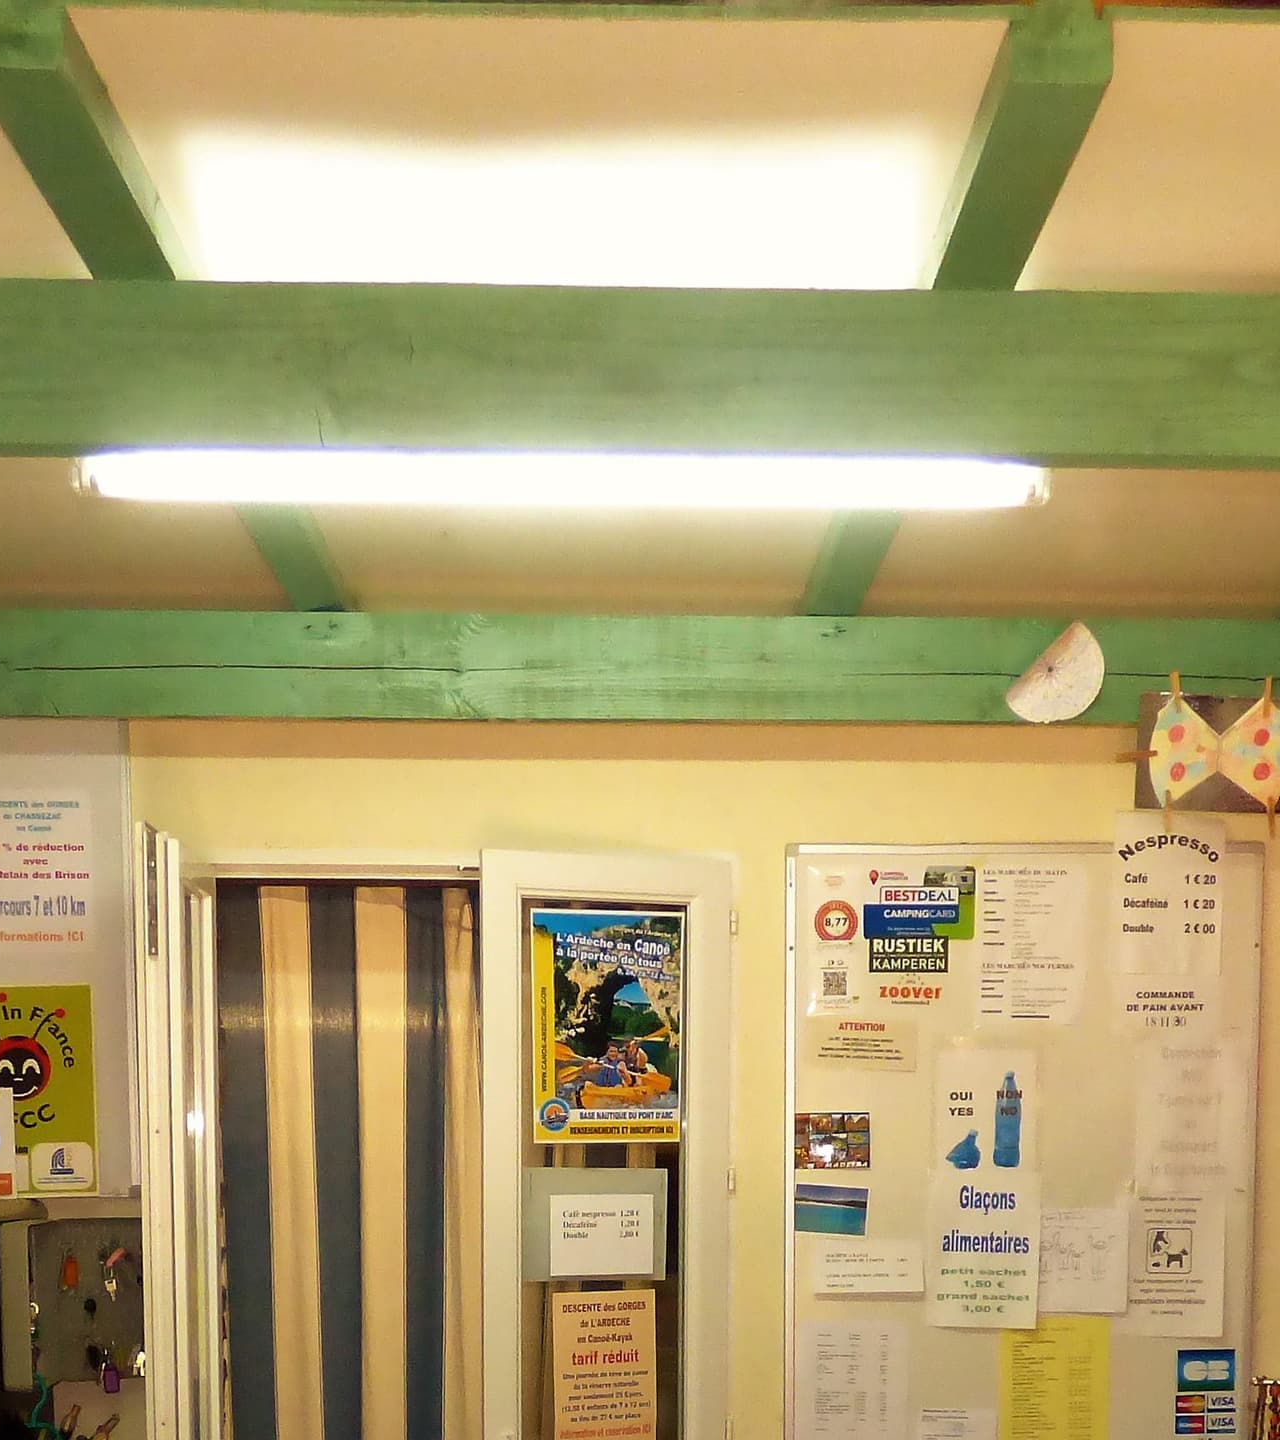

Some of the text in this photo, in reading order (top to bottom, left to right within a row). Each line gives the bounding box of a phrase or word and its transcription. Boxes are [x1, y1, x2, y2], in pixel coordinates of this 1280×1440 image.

[16, 843, 29, 851] de
[32, 842, 84, 851] réduction
[1118, 834, 1219, 863] Nespresso
[32, 870, 51, 879] des
[55, 870, 89, 879] Brison
[1125, 873, 1148, 883] Café
[1194, 874, 1200, 884] €
[1203, 874, 1216, 885] 20
[884, 890, 955, 902] BESTDEAL
[43, 897, 53, 916] et
[56, 895, 67, 916] 10
[70, 895, 85, 916] km
[1193, 899, 1199, 909] €
[1202, 899, 1215, 909] 20
[824, 917, 848, 928] 8,77
[1123, 923, 1215, 934] Double 2 € 00
[556, 932, 614, 949] L'Ardèche
[616, 941, 631, 951] en
[873, 938, 945, 953] RUSTIEK
[567, 947, 577, 958] la
[580, 950, 618, 963] portée
[621, 954, 635, 965] de
[638, 957, 662, 968] tous
[872, 958, 945, 970] KAMPEREN
[879, 986, 942, 999] zoover
[1136, 991, 1195, 999] COMMANDE
[1126, 1004, 1139, 1012] DE
[1143, 1004, 1167, 1012] PAIN
[838, 1021, 886, 1032] ATTENTION
[949, 1090, 1023, 1101] OUI NON
[949, 1107, 1018, 1116] YES NO
[959, 1185, 1016, 1215] Glaçons
[942, 1229, 1030, 1253] alimentaires
[941, 1267, 1027, 1276] petit sachet
[937, 1292, 1030, 1302] grand sachet
[563, 1301, 646, 1313] DESCENTE des GORGES
[572, 1349, 639, 1365] tarif réduit
[1183, 1360, 1230, 1381] CB
[1211, 1397, 1234, 1406] VISA
[1211, 1417, 1234, 1427] VISA
